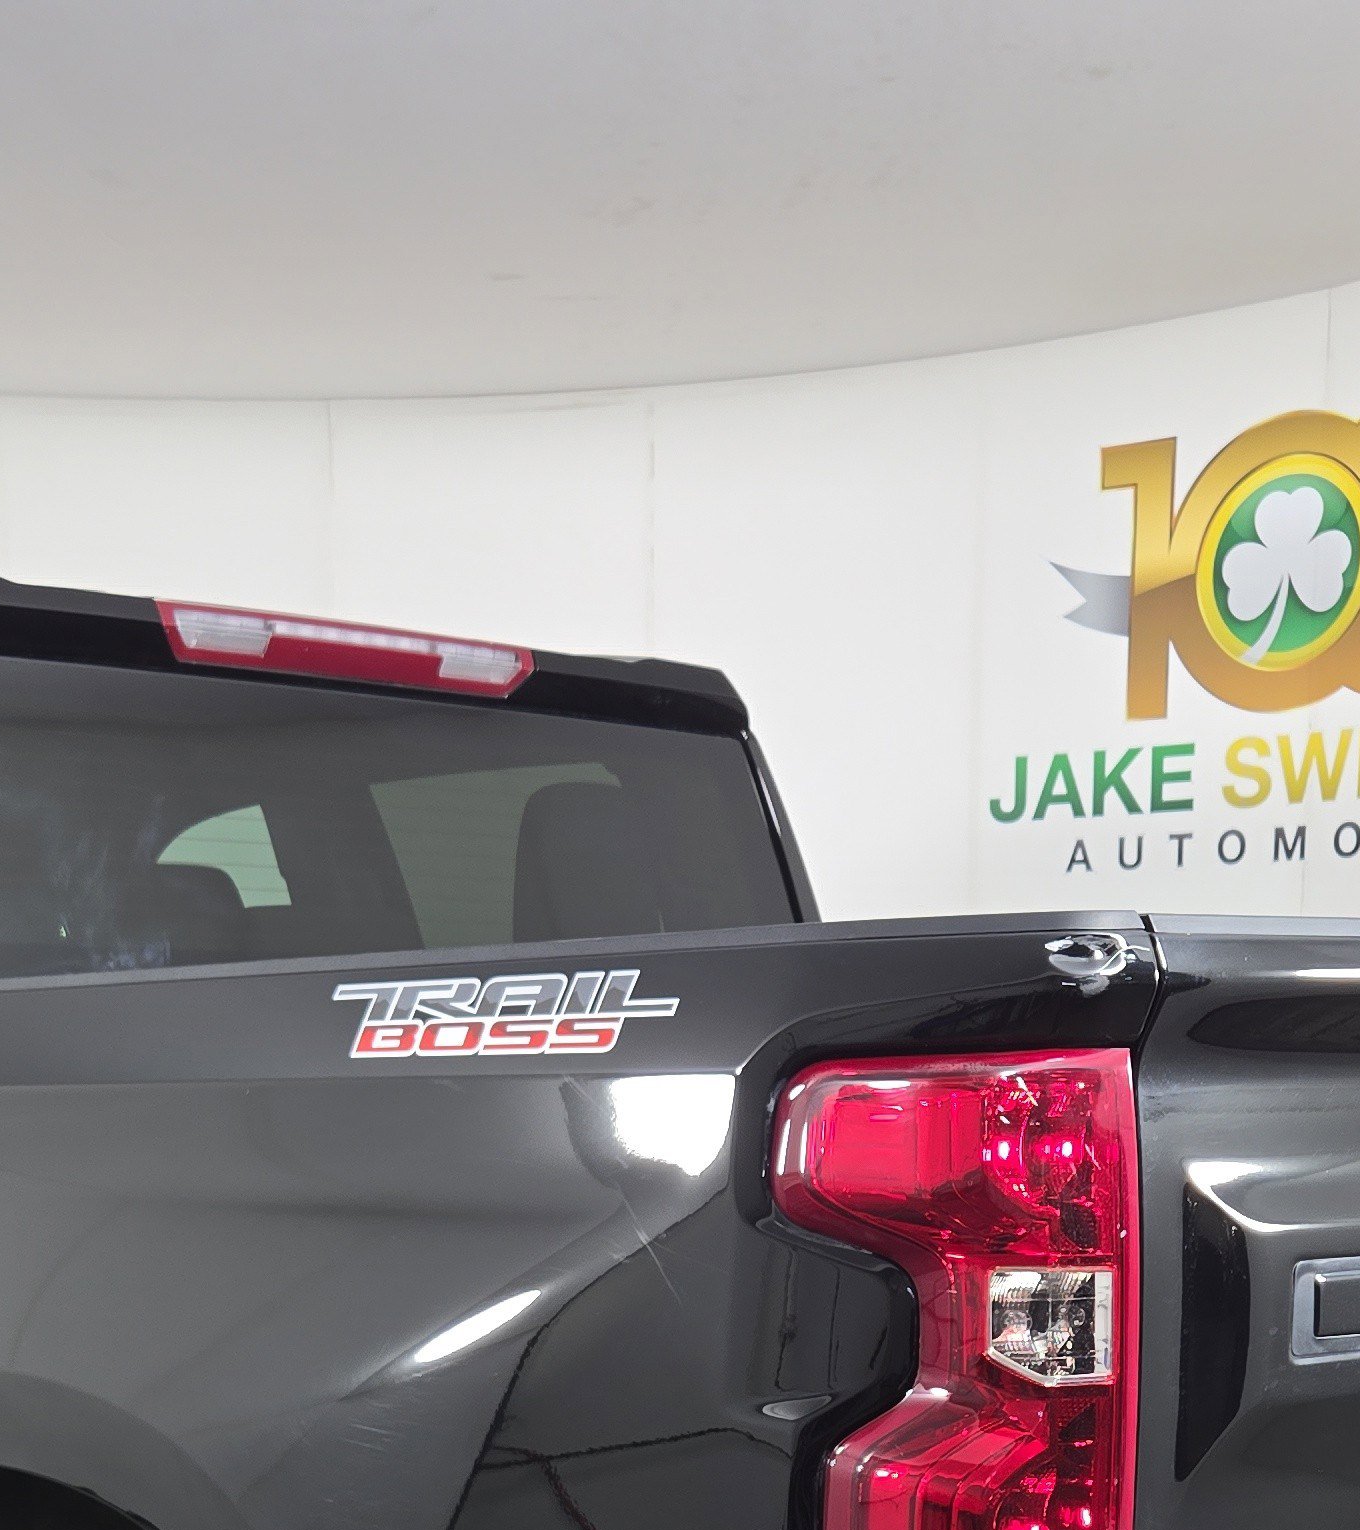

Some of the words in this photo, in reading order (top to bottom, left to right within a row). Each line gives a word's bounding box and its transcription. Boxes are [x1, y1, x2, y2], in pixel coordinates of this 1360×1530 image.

[990, 742, 1197, 824] JAKE
[332, 968, 680, 1021] TRAIL
[350, 1015, 626, 1058] BOSS
